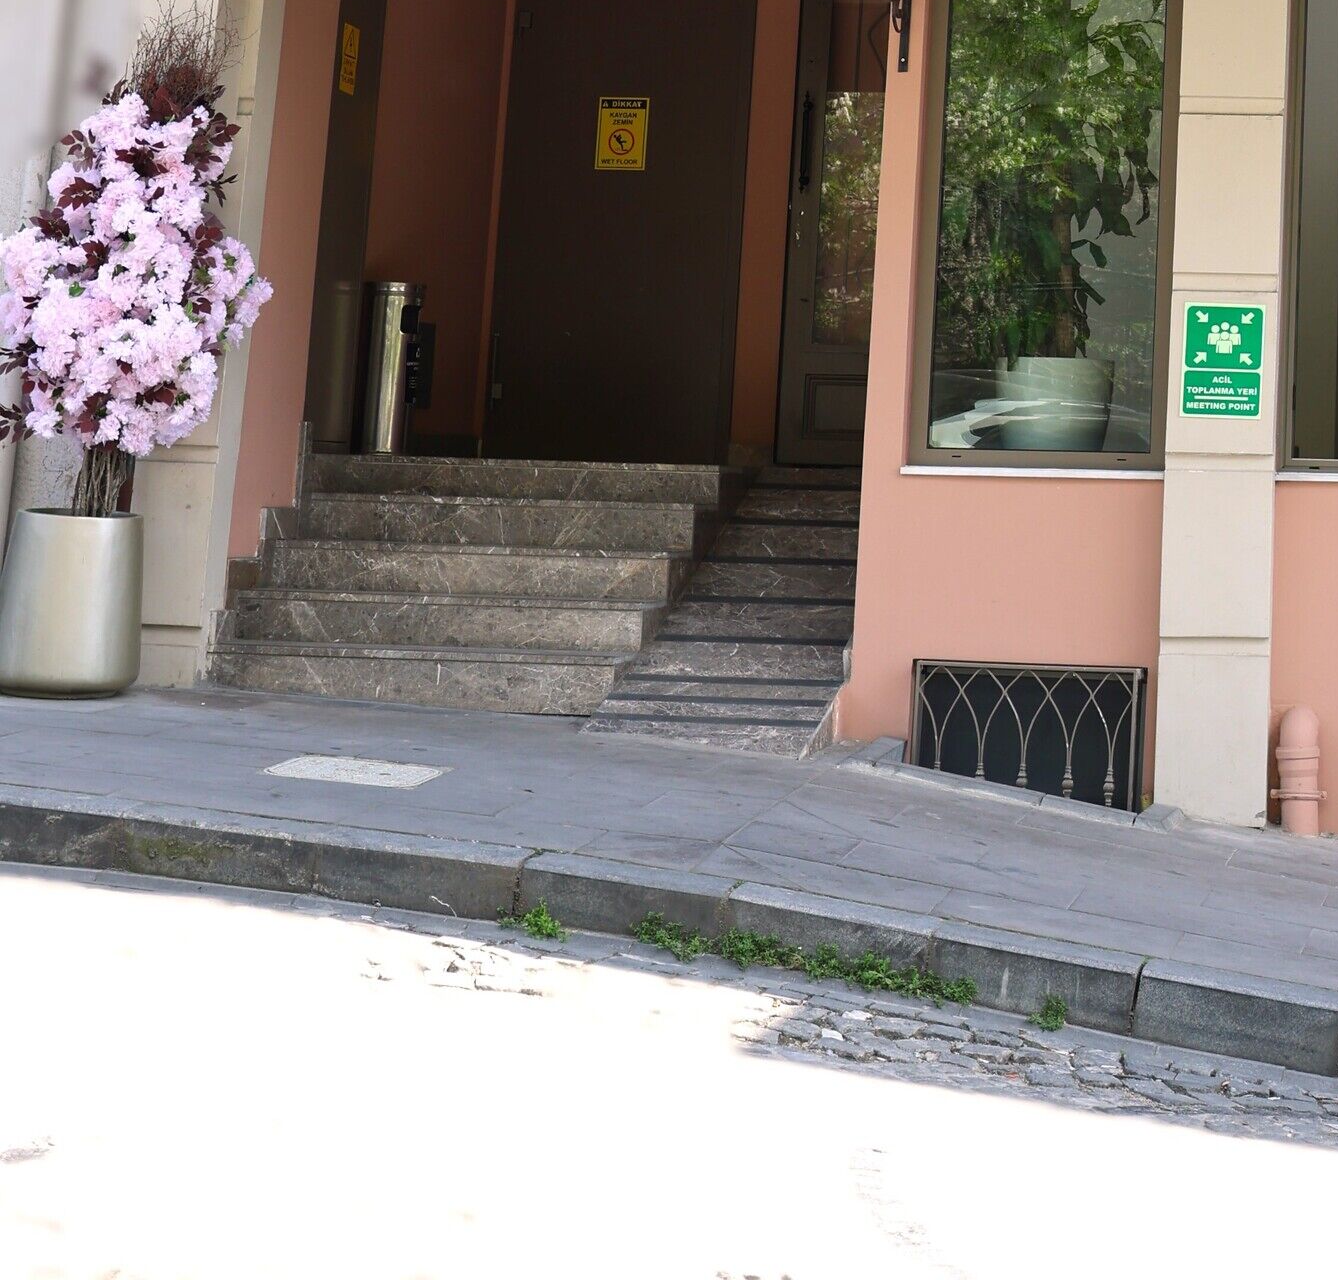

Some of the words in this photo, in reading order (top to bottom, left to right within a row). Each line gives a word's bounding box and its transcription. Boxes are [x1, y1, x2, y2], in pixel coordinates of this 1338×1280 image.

[1212, 375, 1232, 384] ACİL
[1187, 386, 1234, 395] TOPLANMA
[1236, 387, 1257, 396] YERİ
[1186, 402, 1226, 410] MEETING
